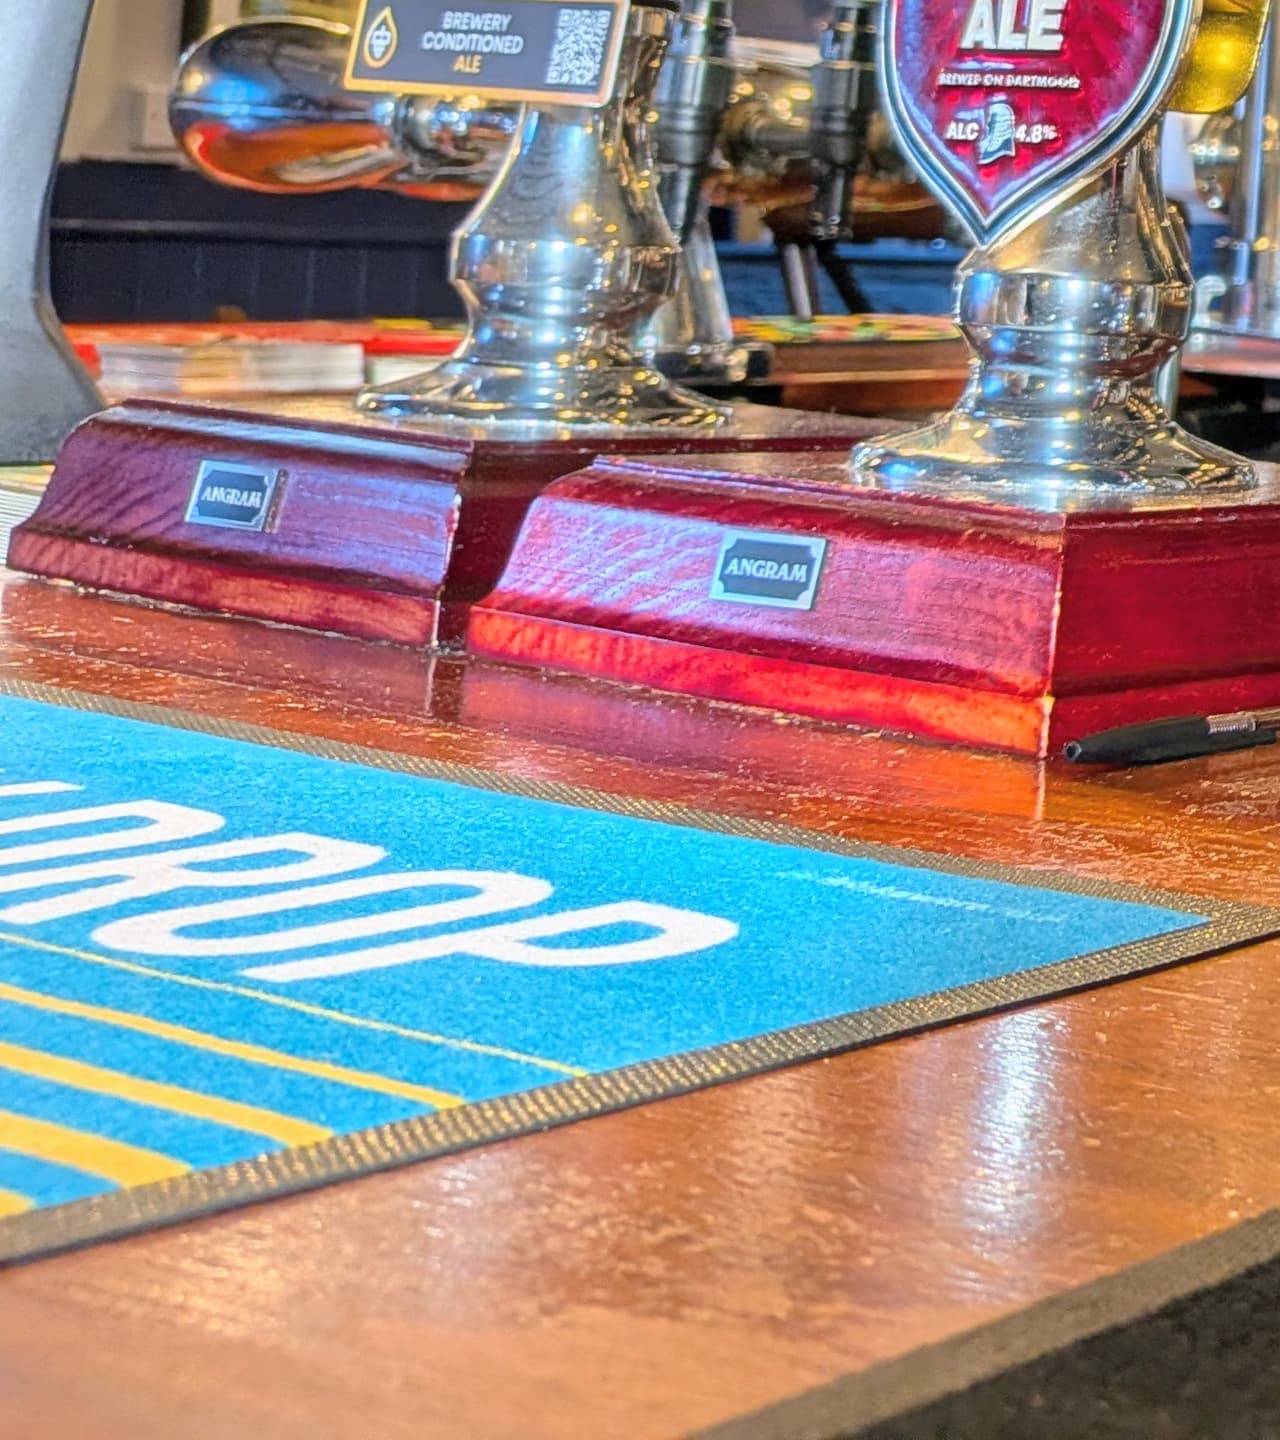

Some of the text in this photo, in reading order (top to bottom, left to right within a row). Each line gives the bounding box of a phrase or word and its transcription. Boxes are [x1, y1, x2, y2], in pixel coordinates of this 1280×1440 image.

[442, 11, 512, 31] BREWERY
[421, 32, 524, 55] CONDITIONED
[453, 55, 482, 74] ALE
[983, 73, 1004, 87] ON
[1005, 74, 1081, 90] DARTMOOR
[945, 120, 1059, 144] ALC 4.8%
[201, 486, 262, 508] ANGRAM
[725, 558, 808, 582] ANGRAM
